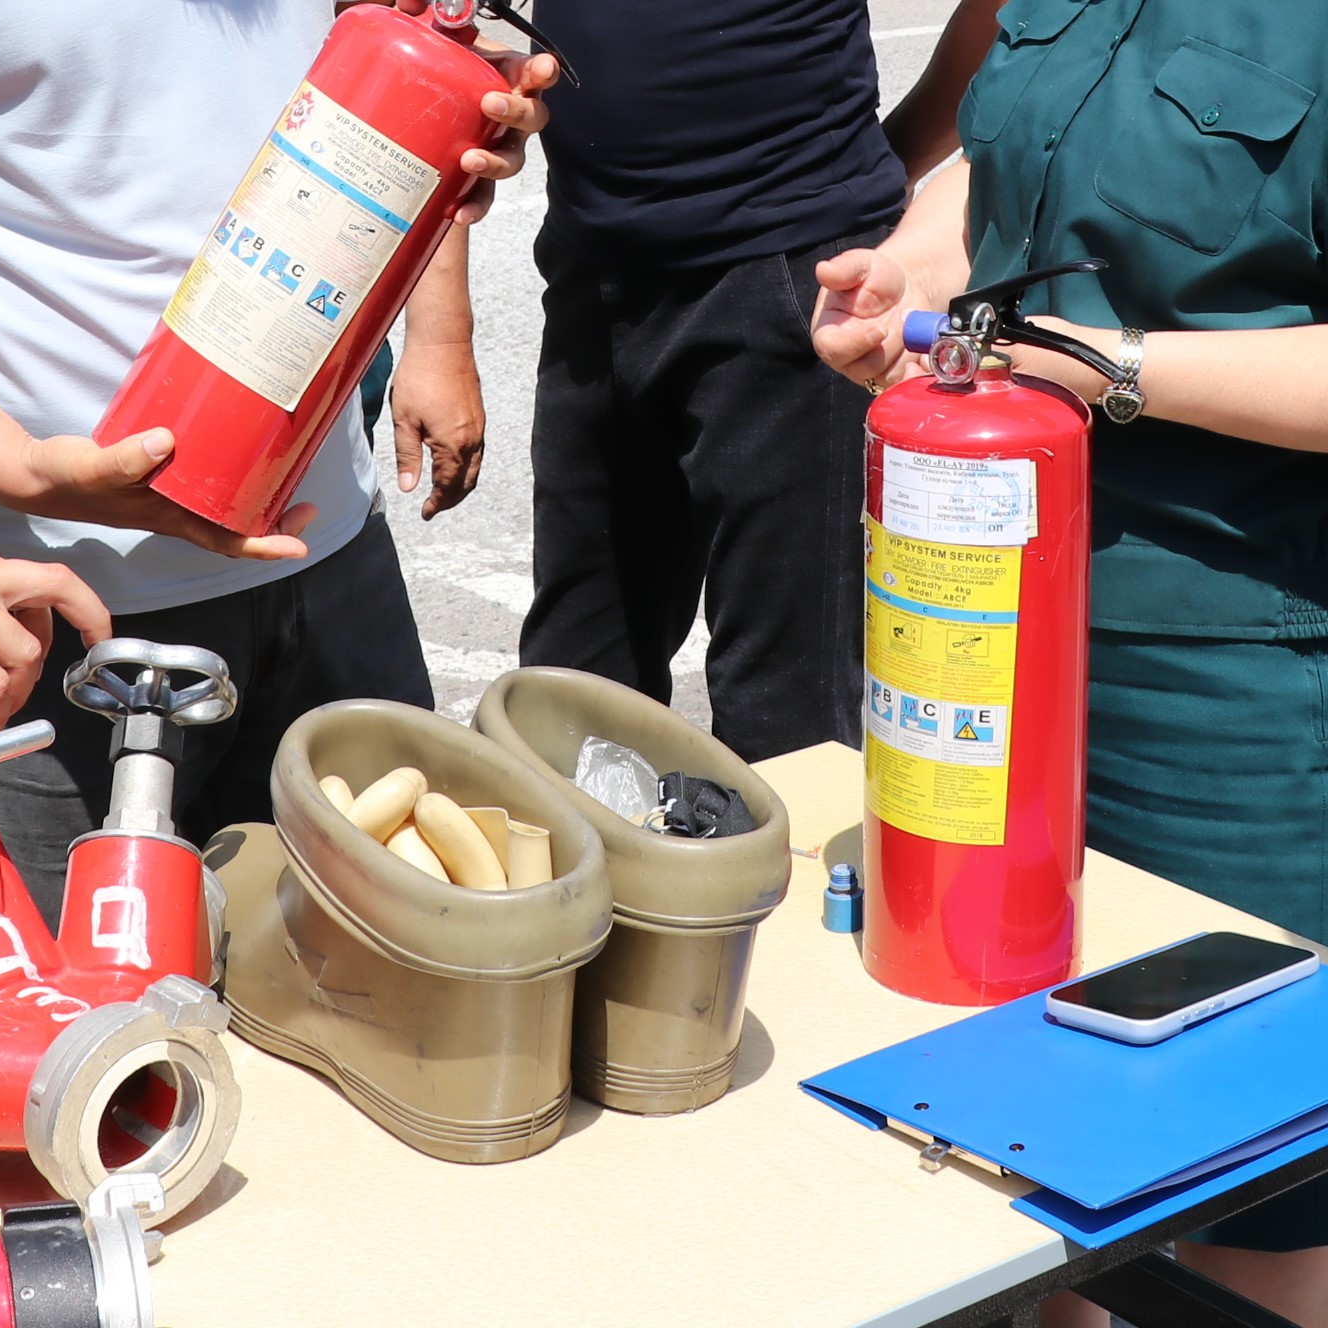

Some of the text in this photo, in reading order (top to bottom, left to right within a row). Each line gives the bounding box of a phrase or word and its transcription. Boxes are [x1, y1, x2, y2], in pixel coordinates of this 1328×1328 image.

[335, 113, 428, 179] VIP SYSTEM SERVICE
[338, 130, 366, 151] POWDER
[367, 149, 383, 162] FIRE
[333, 160, 356, 179] Model
[363, 180, 384, 197] ABCE
[334, 150, 369, 177] Capacity
[375, 178, 391, 192] 4kg
[228, 217, 239, 231] A
[252, 236, 266, 251] B
[290, 262, 306, 279] C
[333, 290, 347, 305] E
[889, 536, 1001, 563] VIP SYSTEM SERVICE
[898, 553, 927, 567] POWDER
[931, 561, 946, 572] FIRE
[952, 565, 1007, 576] EXTINGUISHER
[905, 575, 942, 591] Capacity
[954, 586, 971, 595] 4kg
[908, 586, 932, 597] Model
[943, 594, 967, 603] ABCE
[883, 688, 892, 702] B
[923, 703, 937, 716] C
[979, 710, 991, 723] E
